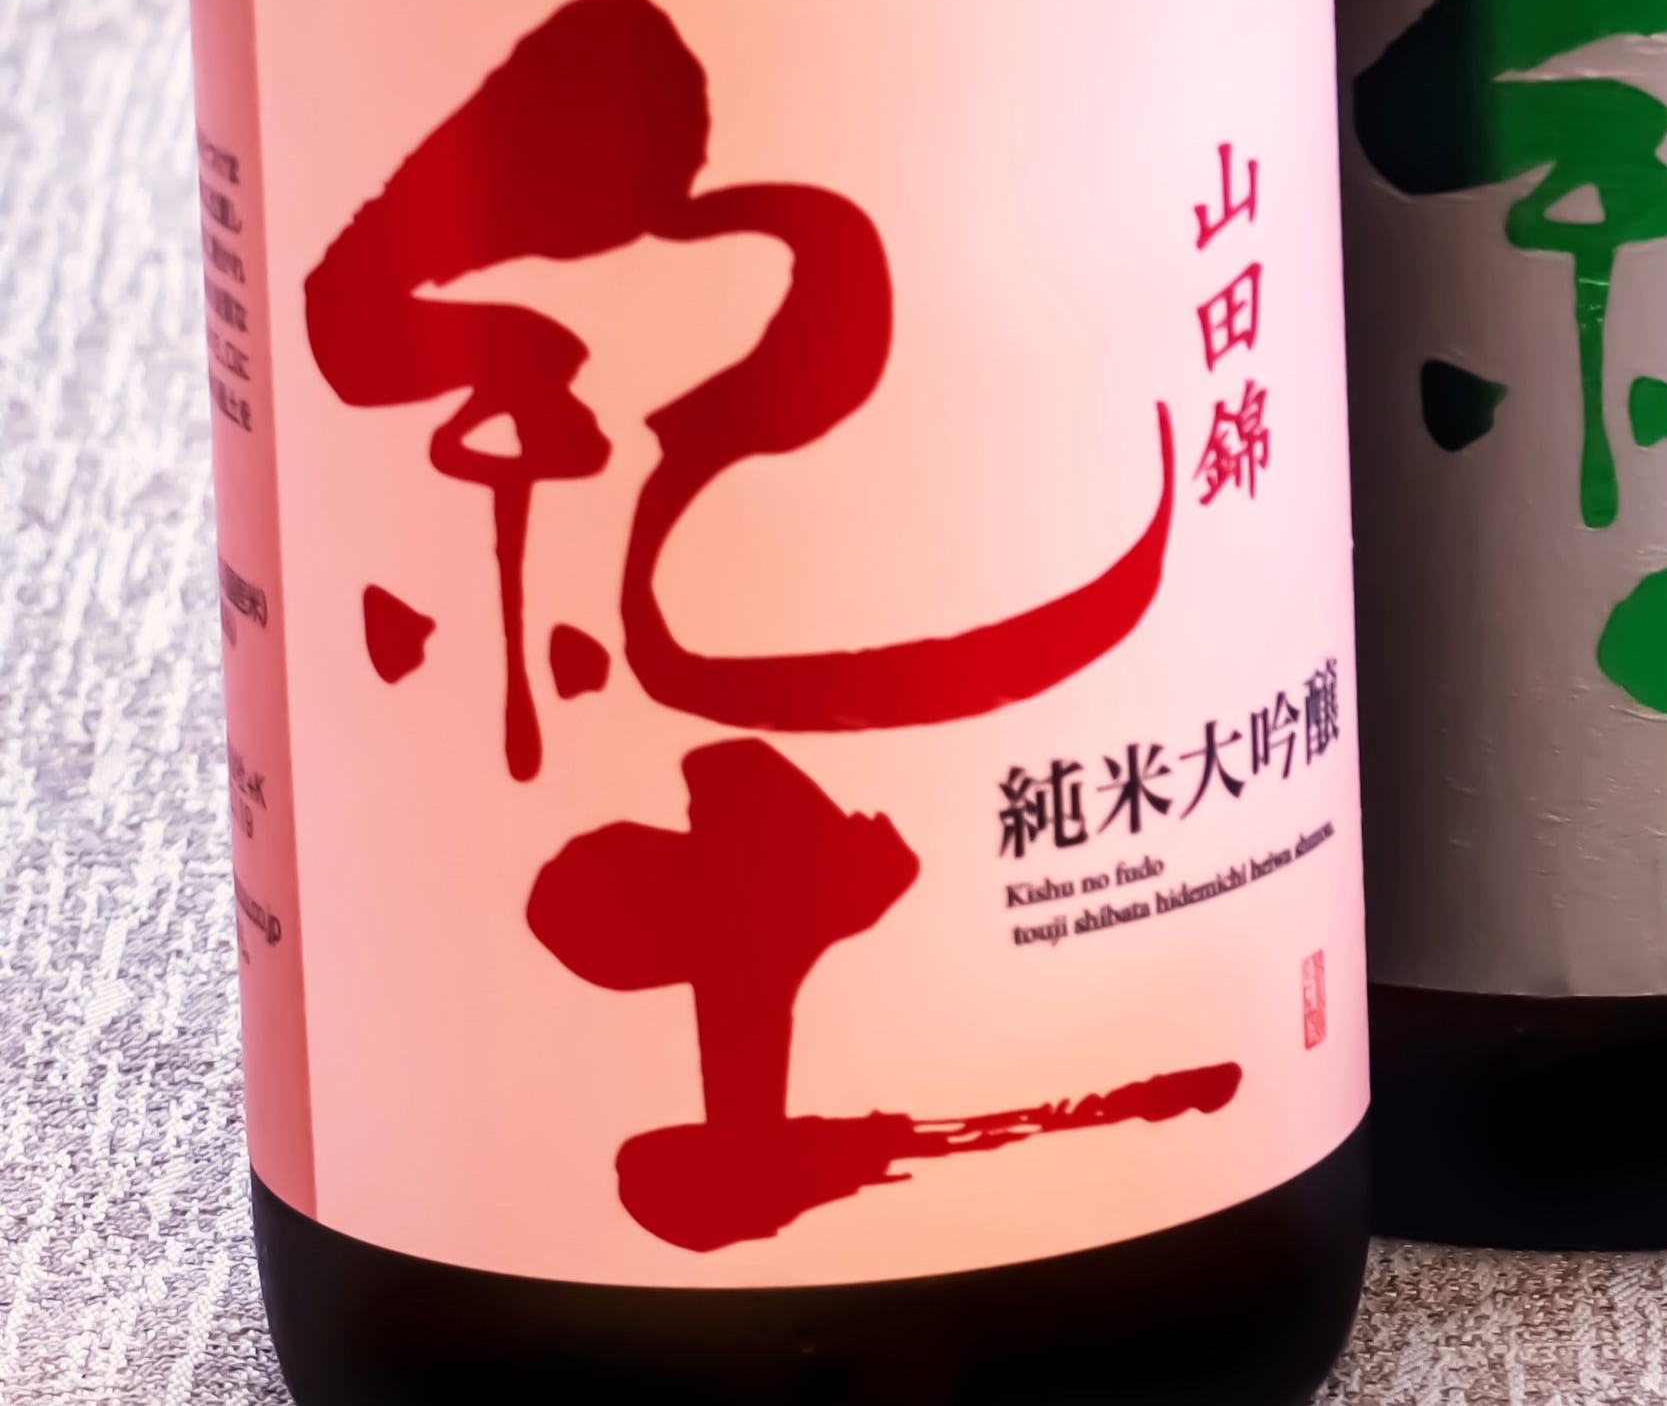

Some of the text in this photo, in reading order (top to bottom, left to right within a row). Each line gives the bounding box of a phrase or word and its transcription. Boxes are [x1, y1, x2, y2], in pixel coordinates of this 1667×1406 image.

[1193, 143, 1270, 506] 山田錦
[998, 658, 1340, 859] 純米大吟醸
[1006, 856, 1165, 909] Kishu no fudo
[1013, 914, 1069, 948] touji
[1074, 892, 1151, 935] shibata
